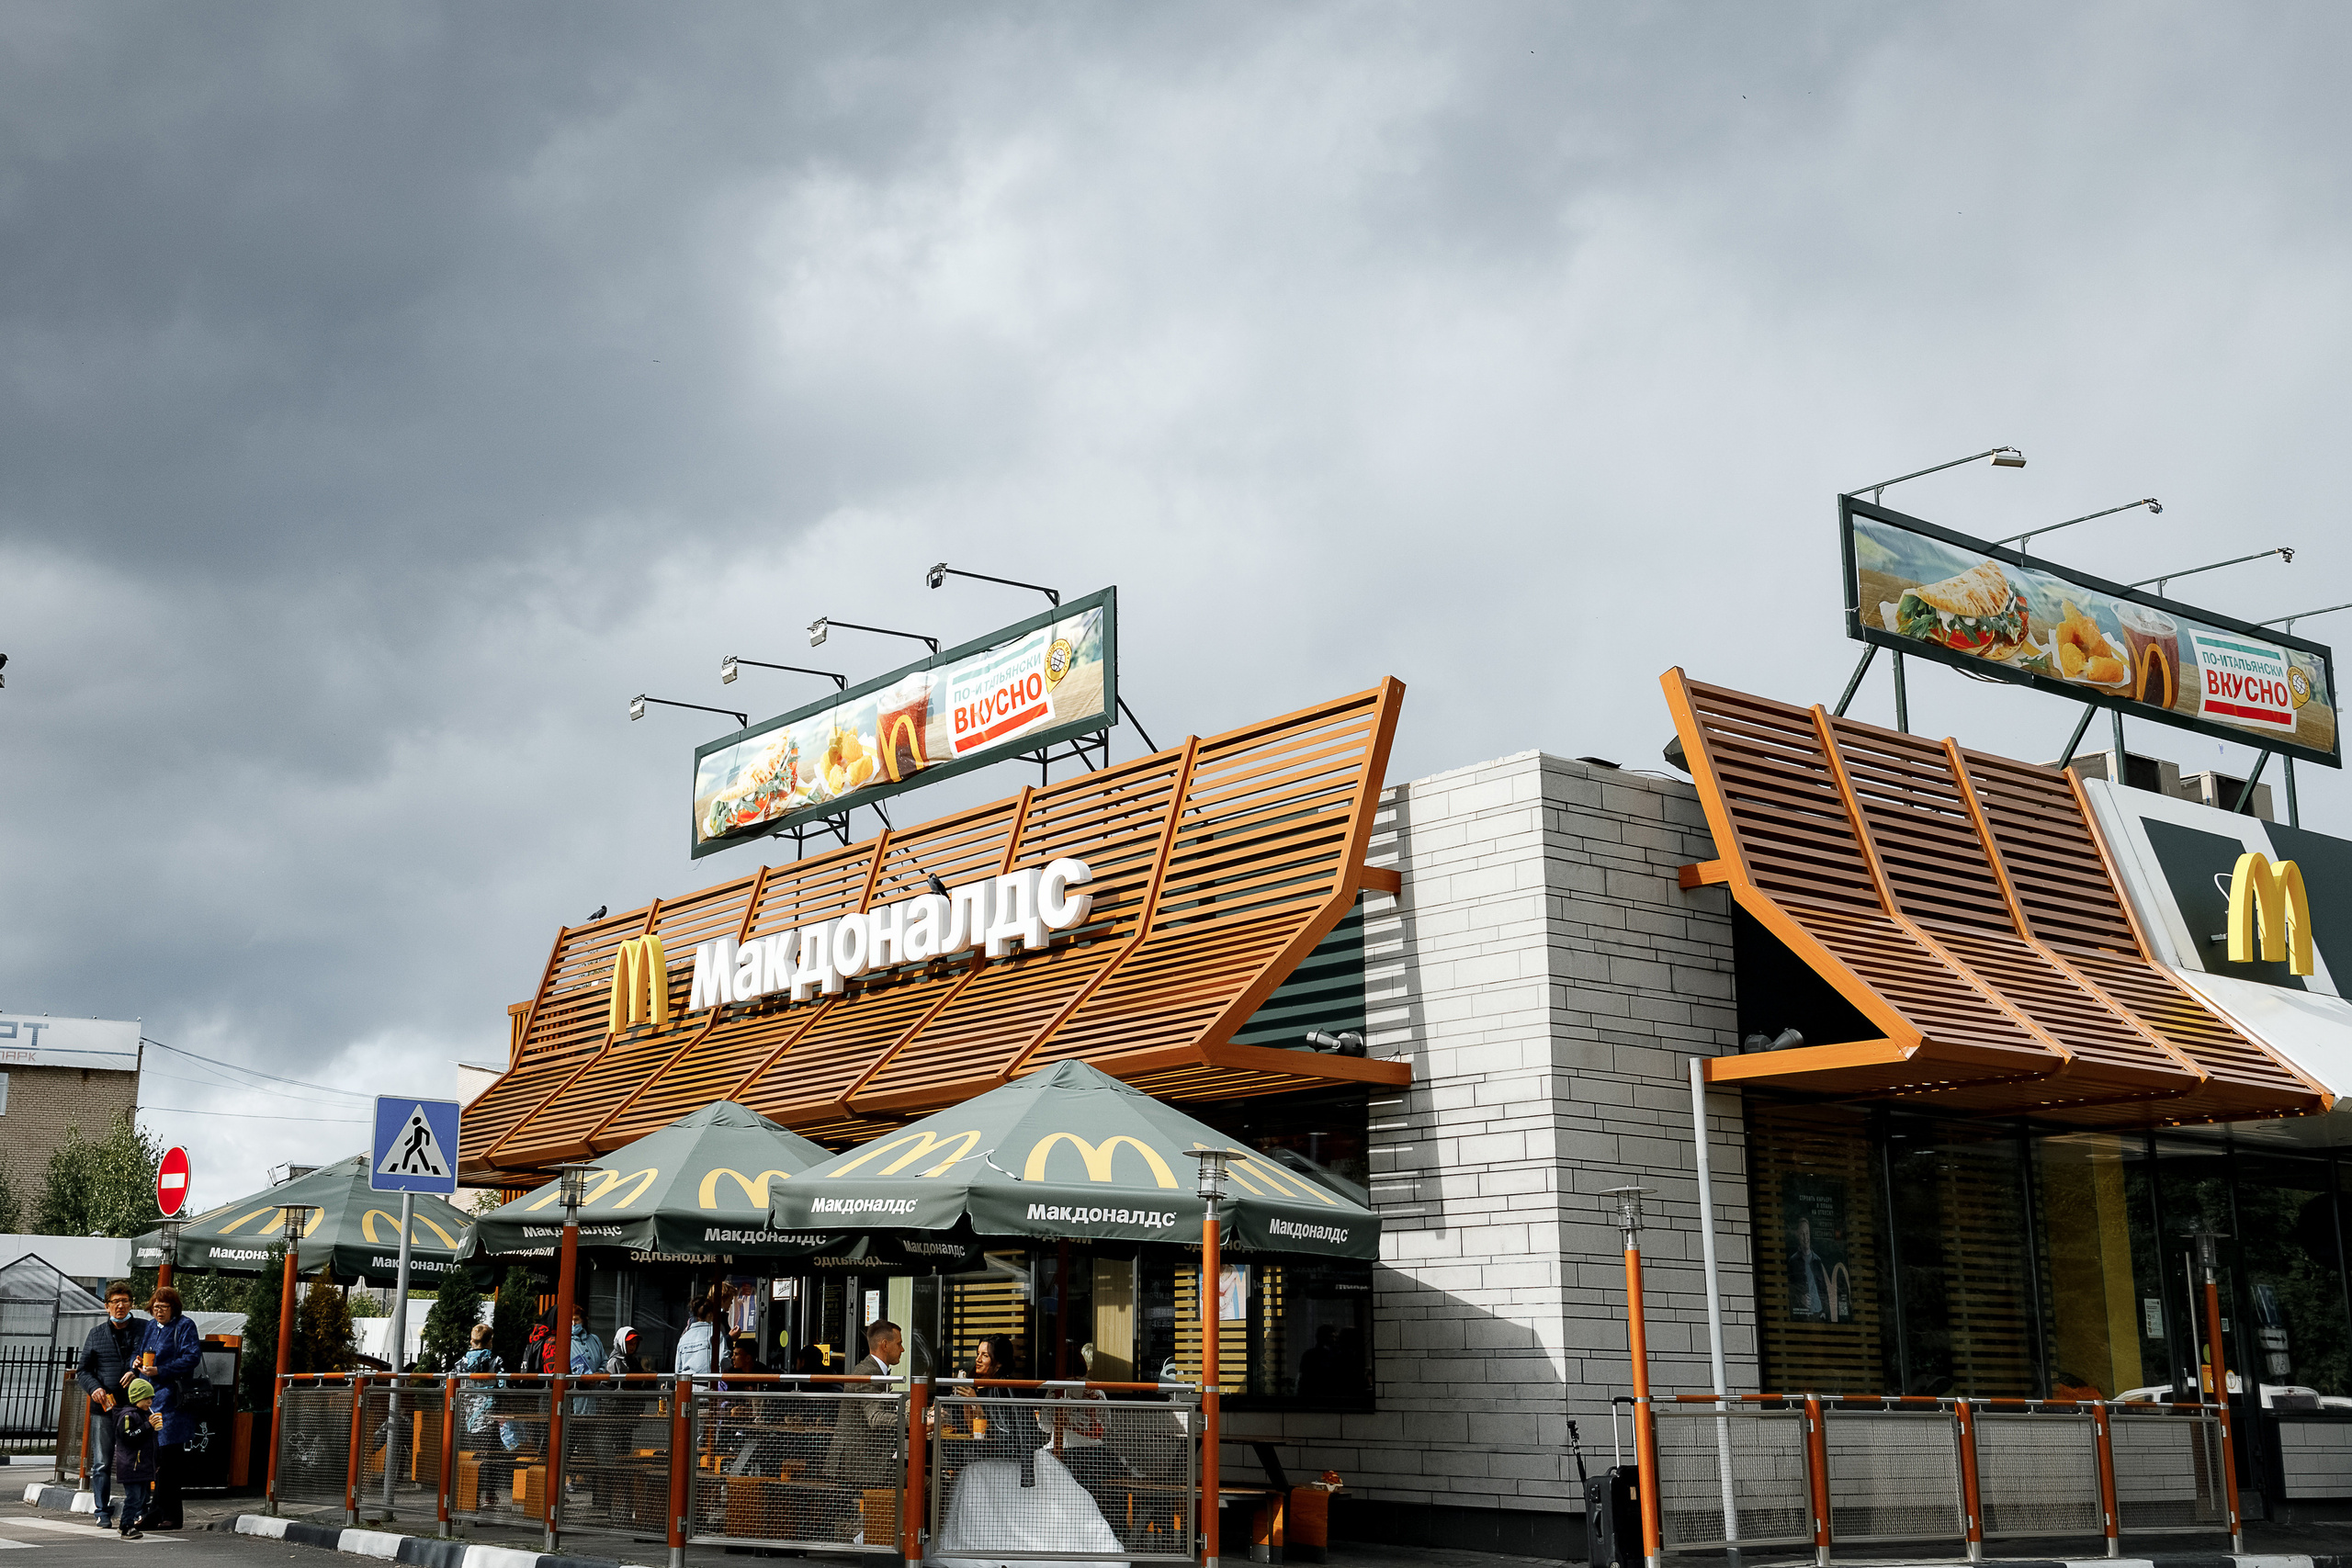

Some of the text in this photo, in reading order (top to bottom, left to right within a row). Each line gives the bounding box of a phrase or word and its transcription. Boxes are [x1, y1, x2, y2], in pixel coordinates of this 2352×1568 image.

[2201, 651, 2284, 678] ПО-ИТАЛЬЯНСКИ
[2206, 669, 2288, 707] ВКУСНО
[954, 672, 1042, 735] ВКУСНО
[689, 858, 1091, 1011] Макдоналдс
[810, 1197, 918, 1215] Макдоналдс
[1026, 1203, 1176, 1229] Макдоналдс
[1269, 1218, 1349, 1245] Макдоналдс
[902, 1240, 966, 1258] Макдоналдс
